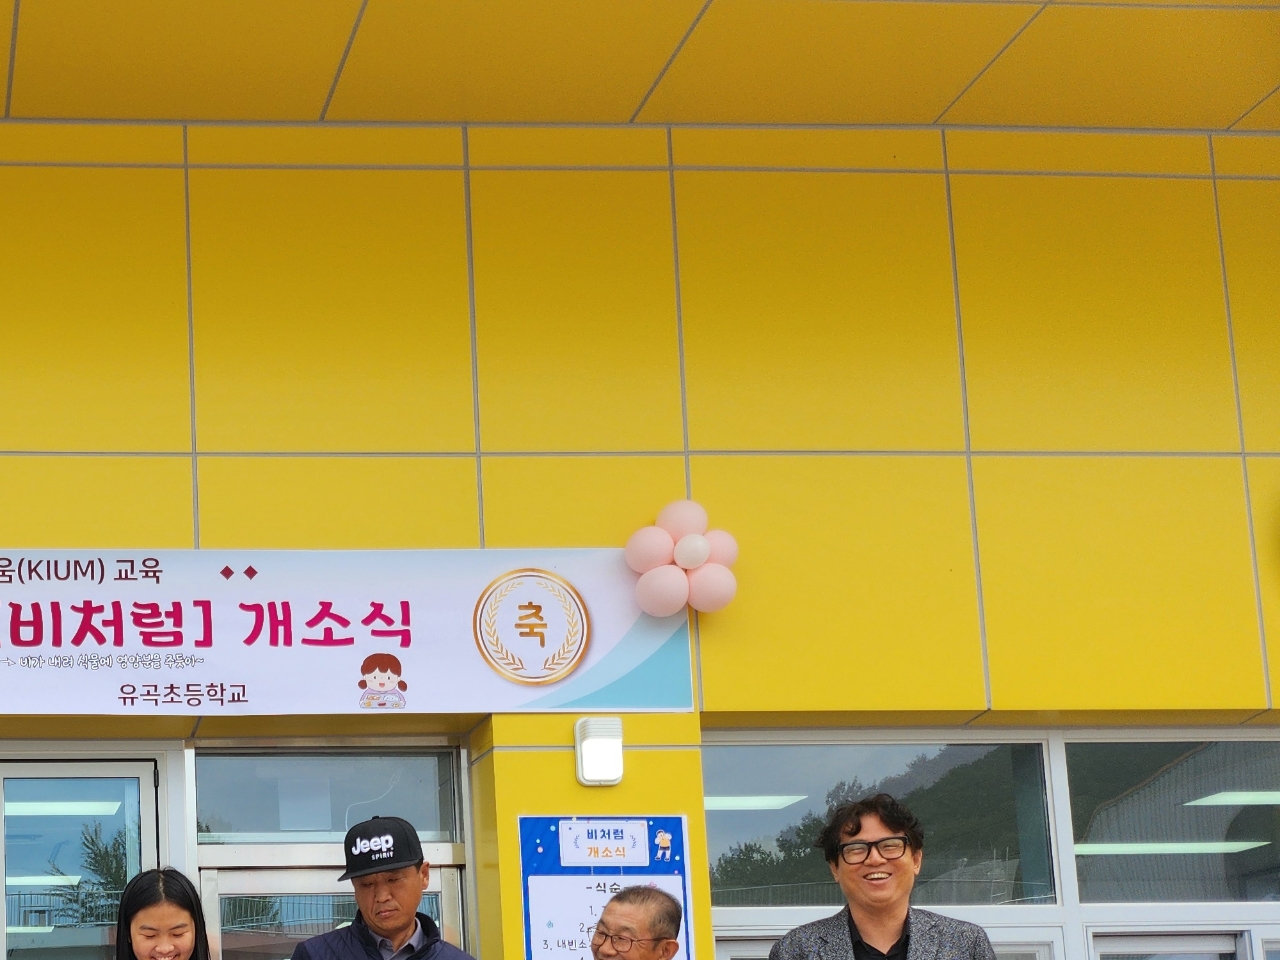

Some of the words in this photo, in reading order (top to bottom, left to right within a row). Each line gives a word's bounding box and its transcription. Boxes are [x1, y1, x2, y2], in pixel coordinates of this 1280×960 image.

[113, 558, 164, 584] 교육
[238, 600, 413, 650] 개소식
[514, 601, 549, 649] 축
[19, 655, 46, 669] 비가
[47, 655, 74, 669] 내려
[77, 653, 114, 671] 식물에
[116, 653, 162, 670] 영양분을
[164, 653, 205, 669] 주듯이~
[117, 682, 249, 708] 유곡초등학교
[586, 828, 625, 841] 비처럼
[351, 834, 394, 856] Jeep
[586, 846, 627, 859] 개소식
[371, 851, 394, 861] SPIRIT
[542, 939, 553, 951] 3.
[556, 939, 592, 951] 내빈소
